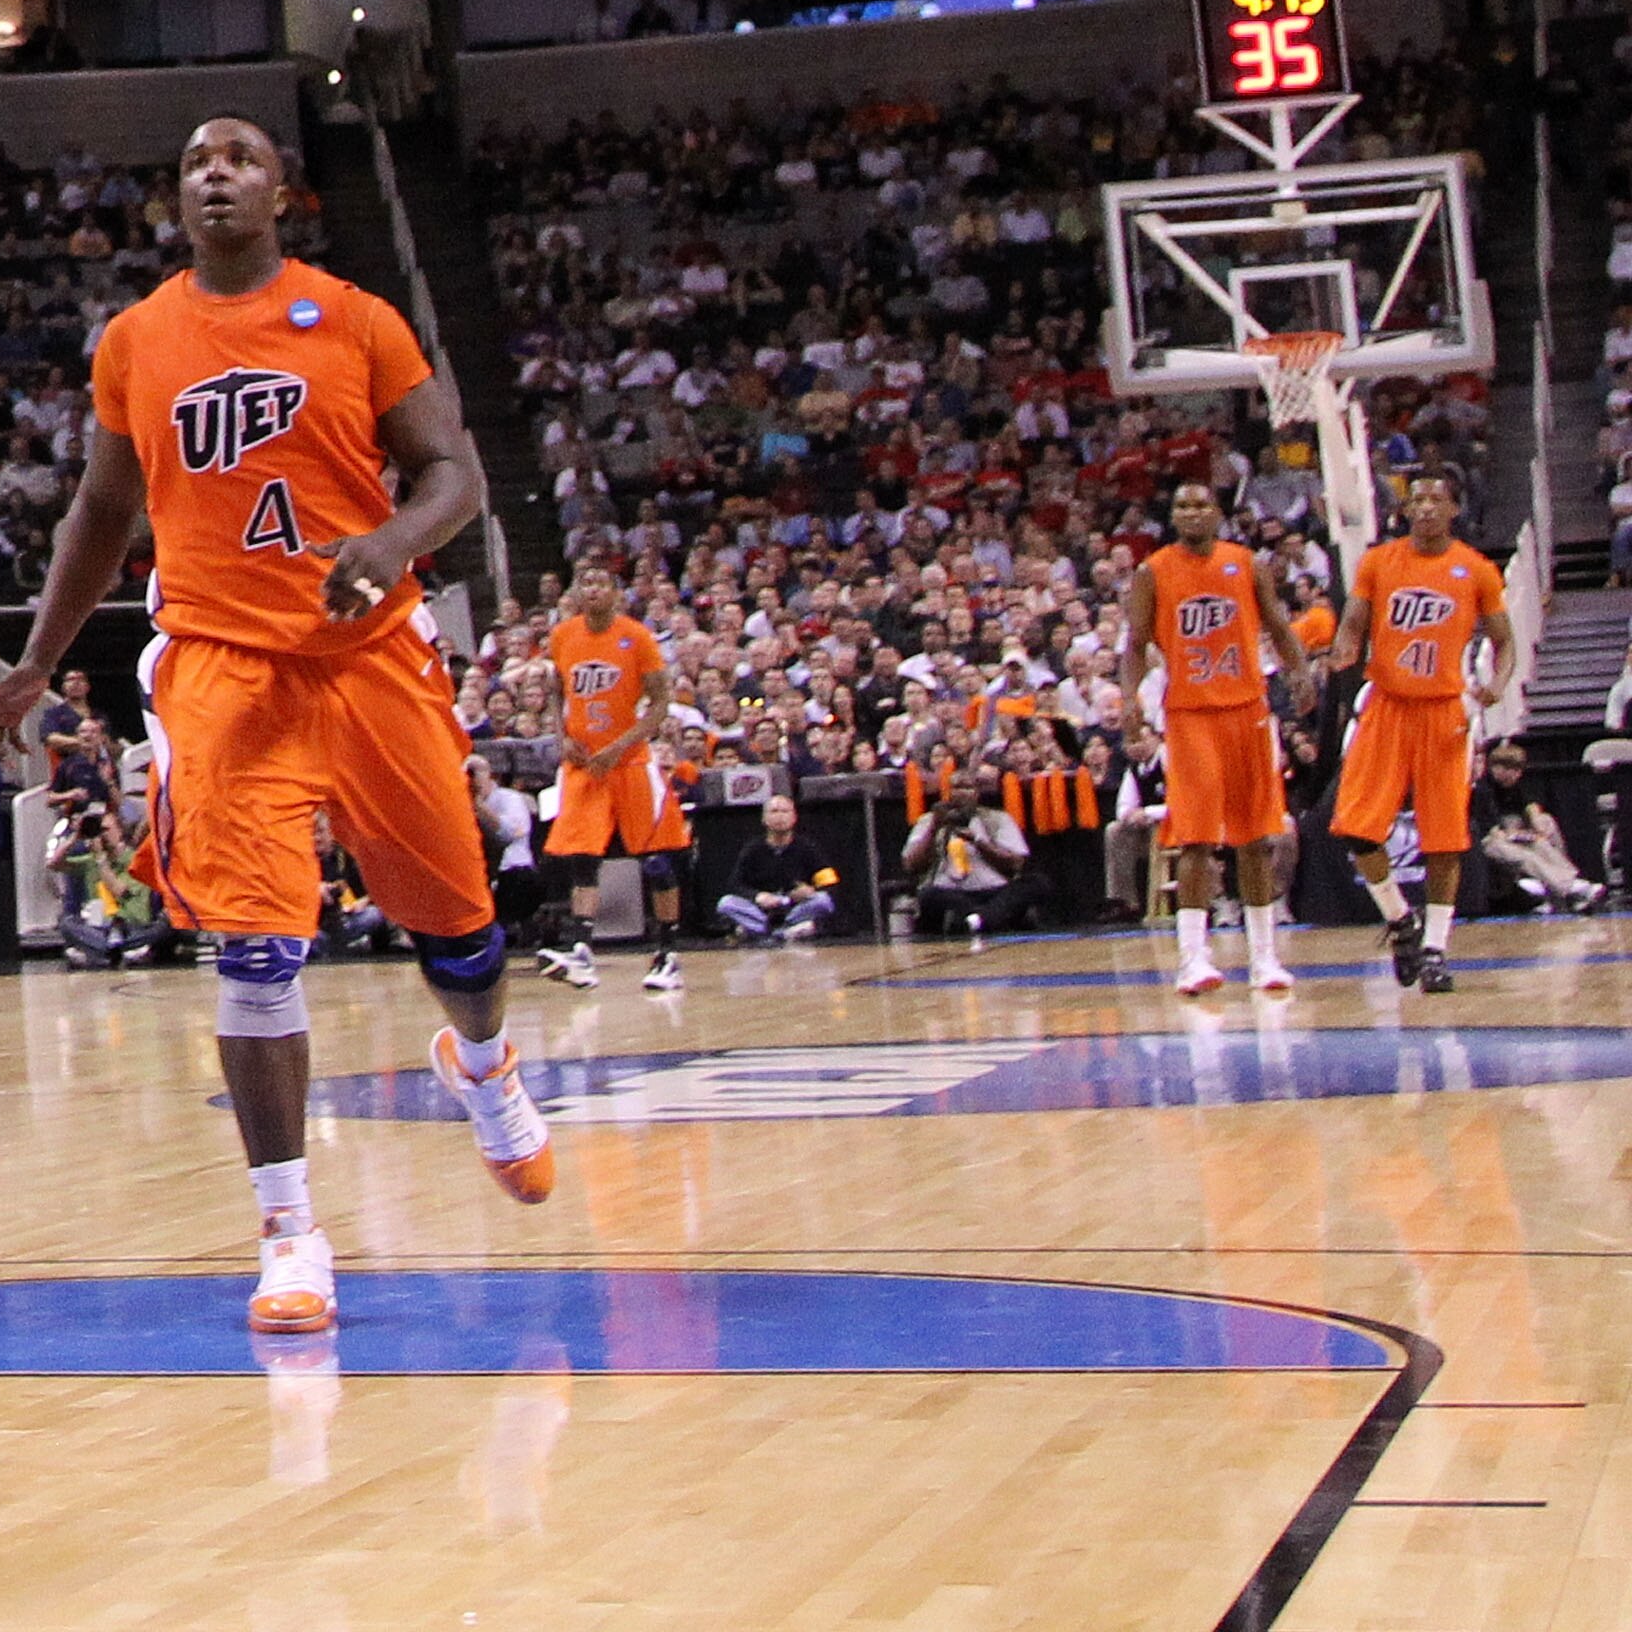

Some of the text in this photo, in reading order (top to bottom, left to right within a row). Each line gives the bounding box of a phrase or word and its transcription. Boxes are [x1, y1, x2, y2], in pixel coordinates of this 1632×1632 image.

[1228, 15, 1325, 94] 35
[171, 366, 308, 474] UTEP
[242, 477, 305, 556] 4
[1177, 593, 1236, 639] UTEP
[1387, 586, 1456, 632] UTEP
[570, 660, 623, 699] UTEP
[1186, 643, 1240, 682] 34
[1397, 639, 1438, 677] 41
[586, 700, 614, 732] 5
